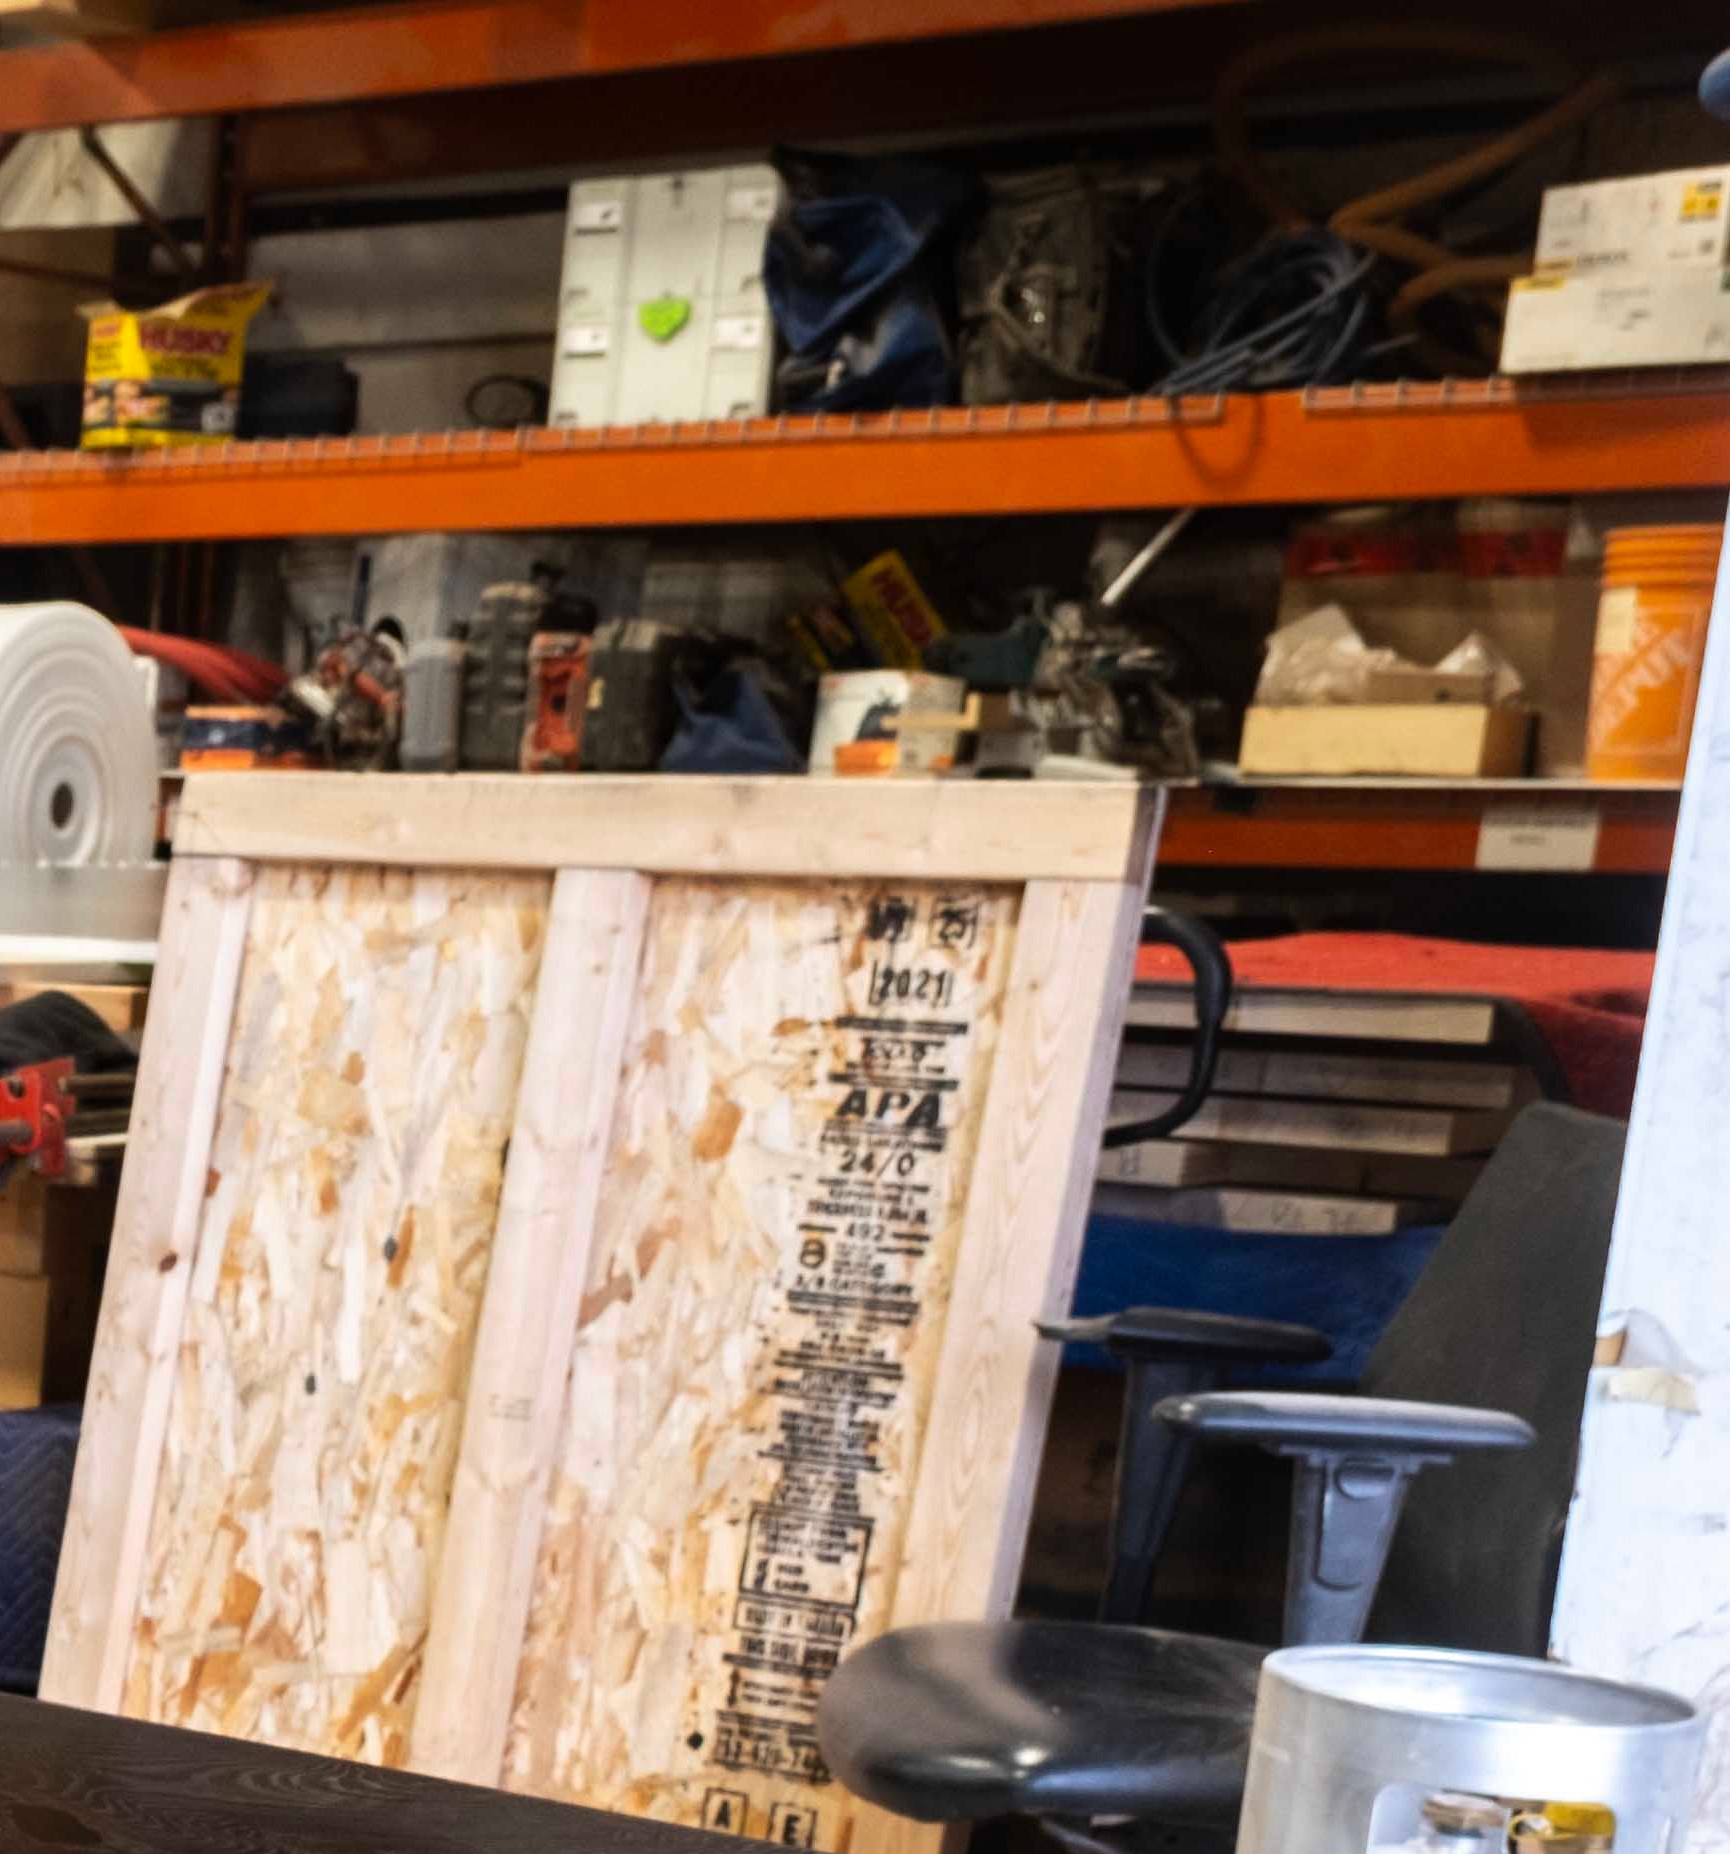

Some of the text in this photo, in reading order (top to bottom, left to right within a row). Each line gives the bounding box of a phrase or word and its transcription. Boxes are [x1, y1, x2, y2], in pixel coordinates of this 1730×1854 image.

[877, 966, 946, 1008] 2021
[836, 1088, 941, 1129] APA
[839, 1150, 915, 1177] 24/0
[714, 1799, 730, 1829] A
[783, 1812, 800, 1847] E
